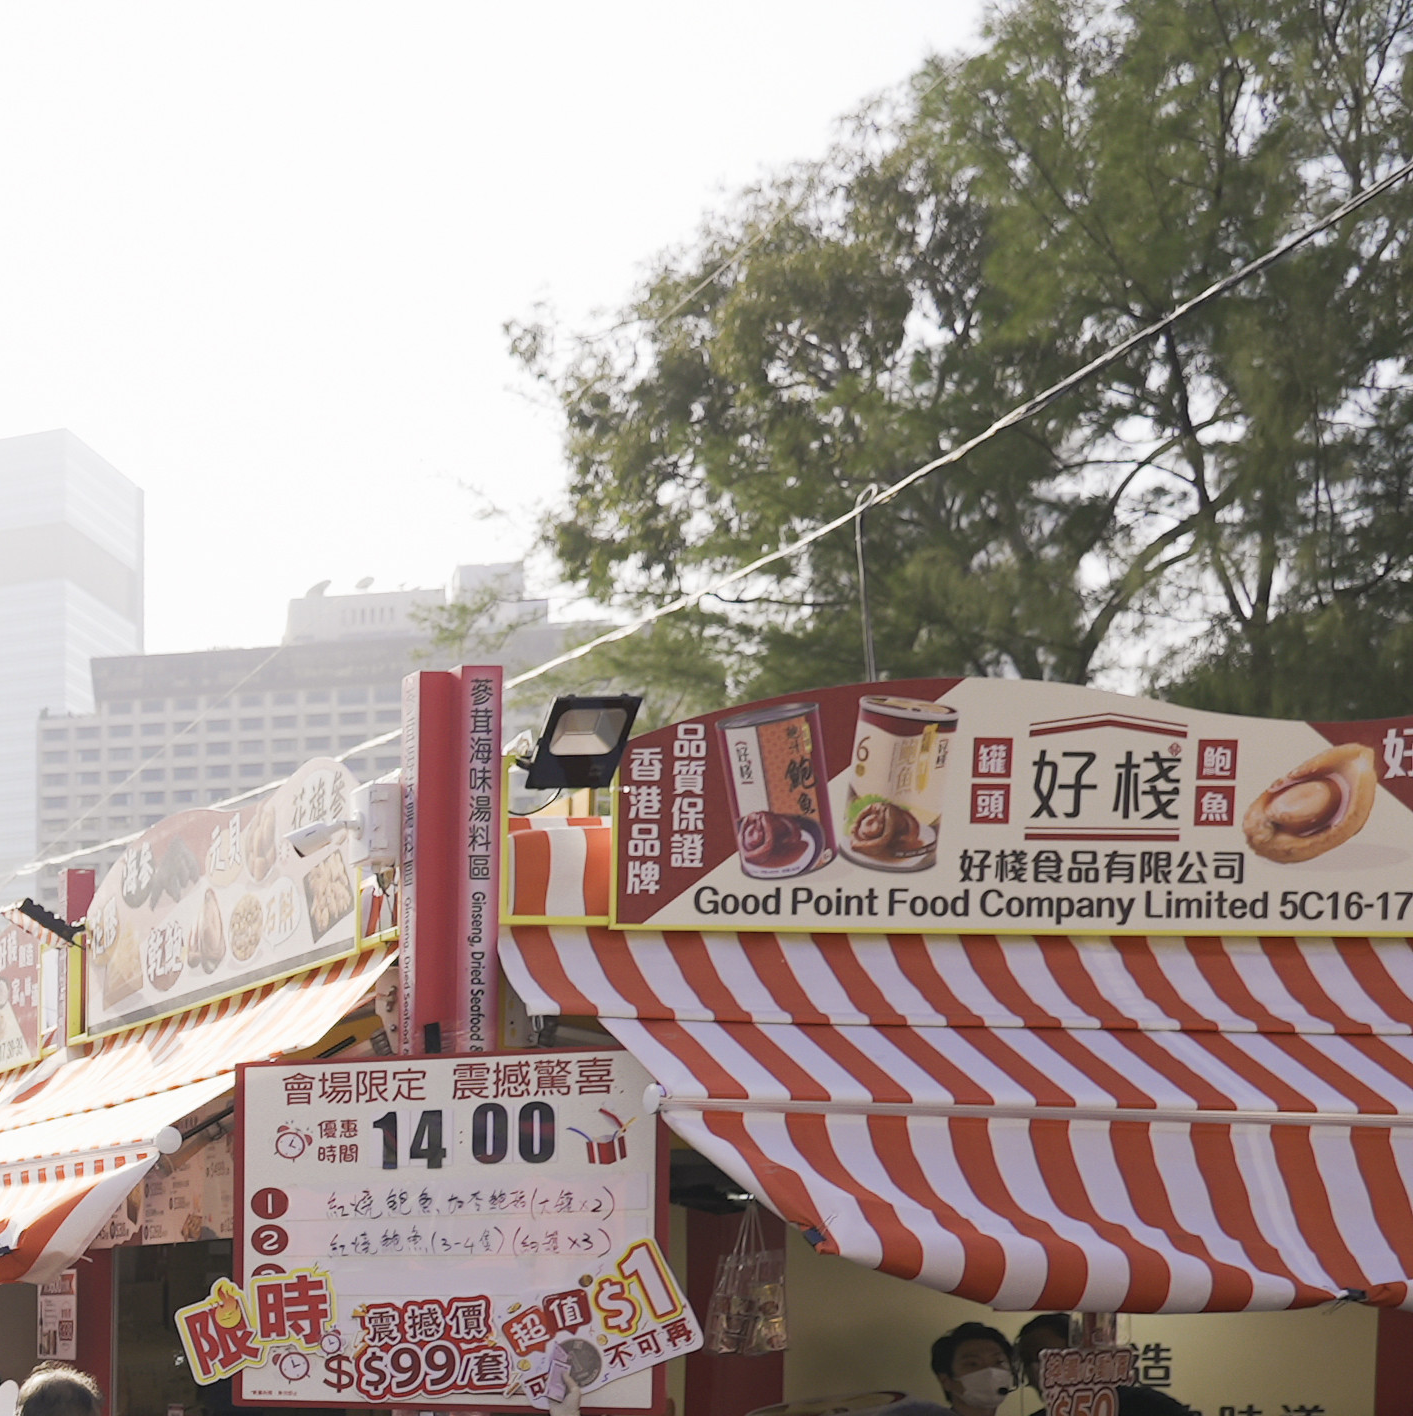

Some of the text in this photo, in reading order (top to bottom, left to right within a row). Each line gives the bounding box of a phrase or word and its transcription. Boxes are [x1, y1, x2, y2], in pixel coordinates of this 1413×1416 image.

[857, 735, 870, 763] 6
[670, 723, 707, 868] 品質保證
[976, 743, 1008, 819] 罐頭
[1031, 747, 1182, 822] 好棧
[1200, 745, 1231, 822] 鮑魚
[626, 746, 663, 895] 香港品牌
[959, 850, 1245, 885] 好棧食品有限公司
[469, 892, 485, 947] Ginseng,
[693, 885, 1413, 927] Good Point Food Company Limited 5C16-17
[471, 951, 484, 985] Dried
[470, 988, 484, 1034] Seafood
[282, 1057, 616, 1107] 會場限定 震撼驚喜
[317, 1118, 359, 1141] 優惠
[317, 1141, 359, 1165] 時間
[373, 1101, 556, 1170] 14:00
[594, 1240, 681, 1333] $1
[183, 1274, 331, 1372] 限時
[366, 1303, 488, 1344] 震撼價
[509, 1295, 585, 1352] 超值
[603, 1316, 693, 1369] 不可再
